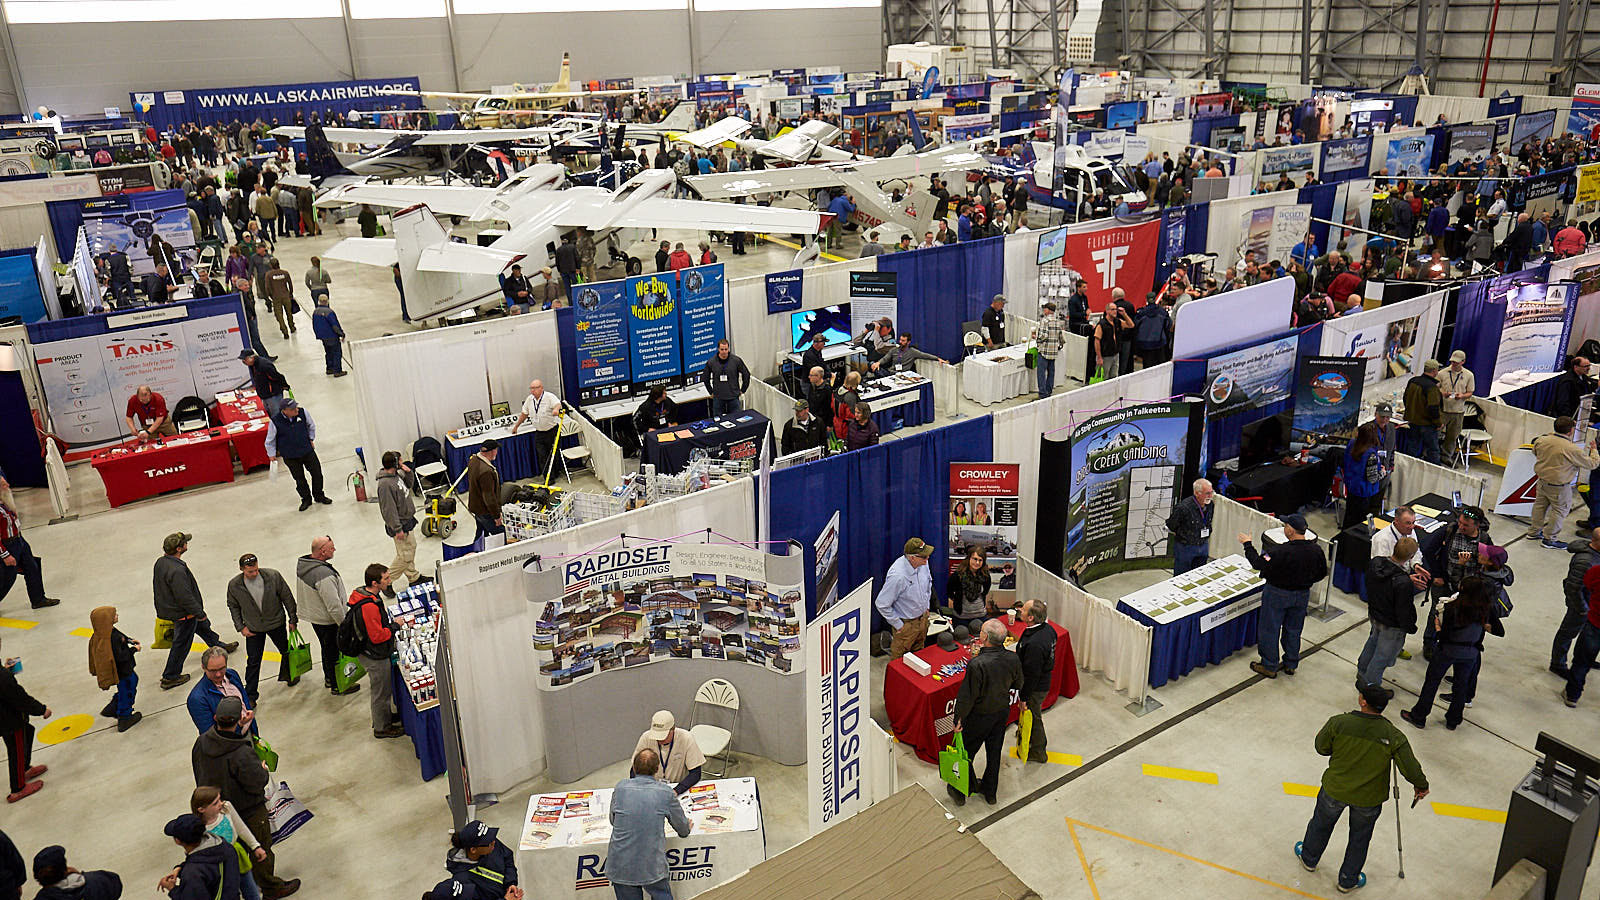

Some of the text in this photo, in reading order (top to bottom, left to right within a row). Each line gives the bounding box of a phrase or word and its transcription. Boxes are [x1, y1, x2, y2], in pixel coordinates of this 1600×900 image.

[1087, 231, 1134, 248] FLIGHTFLIX
[636, 277, 668, 297] We Buy
[631, 299, 675, 320] Worldwide!
[106, 340, 173, 358] TANIS
[1232, 360, 1246, 368] Ratings
[1274, 347, 1294, 357] Adventures
[1080, 424, 1091, 435] Strip
[1091, 412, 1126, 428] Community
[1133, 406, 1170, 416] Talkeetna
[1093, 446, 1167, 470] CREEK LANDING
[144, 464, 186, 478] TANIS
[959, 470, 1008, 479] CROWLEY
[1098, 546, 1118, 561] 2016
[478, 561, 499, 573] Rapidset
[500, 557, 513, 566] Metal
[565, 545, 672, 585] RAPIDSET
[590, 565, 670, 586] METAL BUILDINGS
[832, 608, 861, 805] RAPIDSET
[821, 676, 834, 823] METAL BUILDINGS
